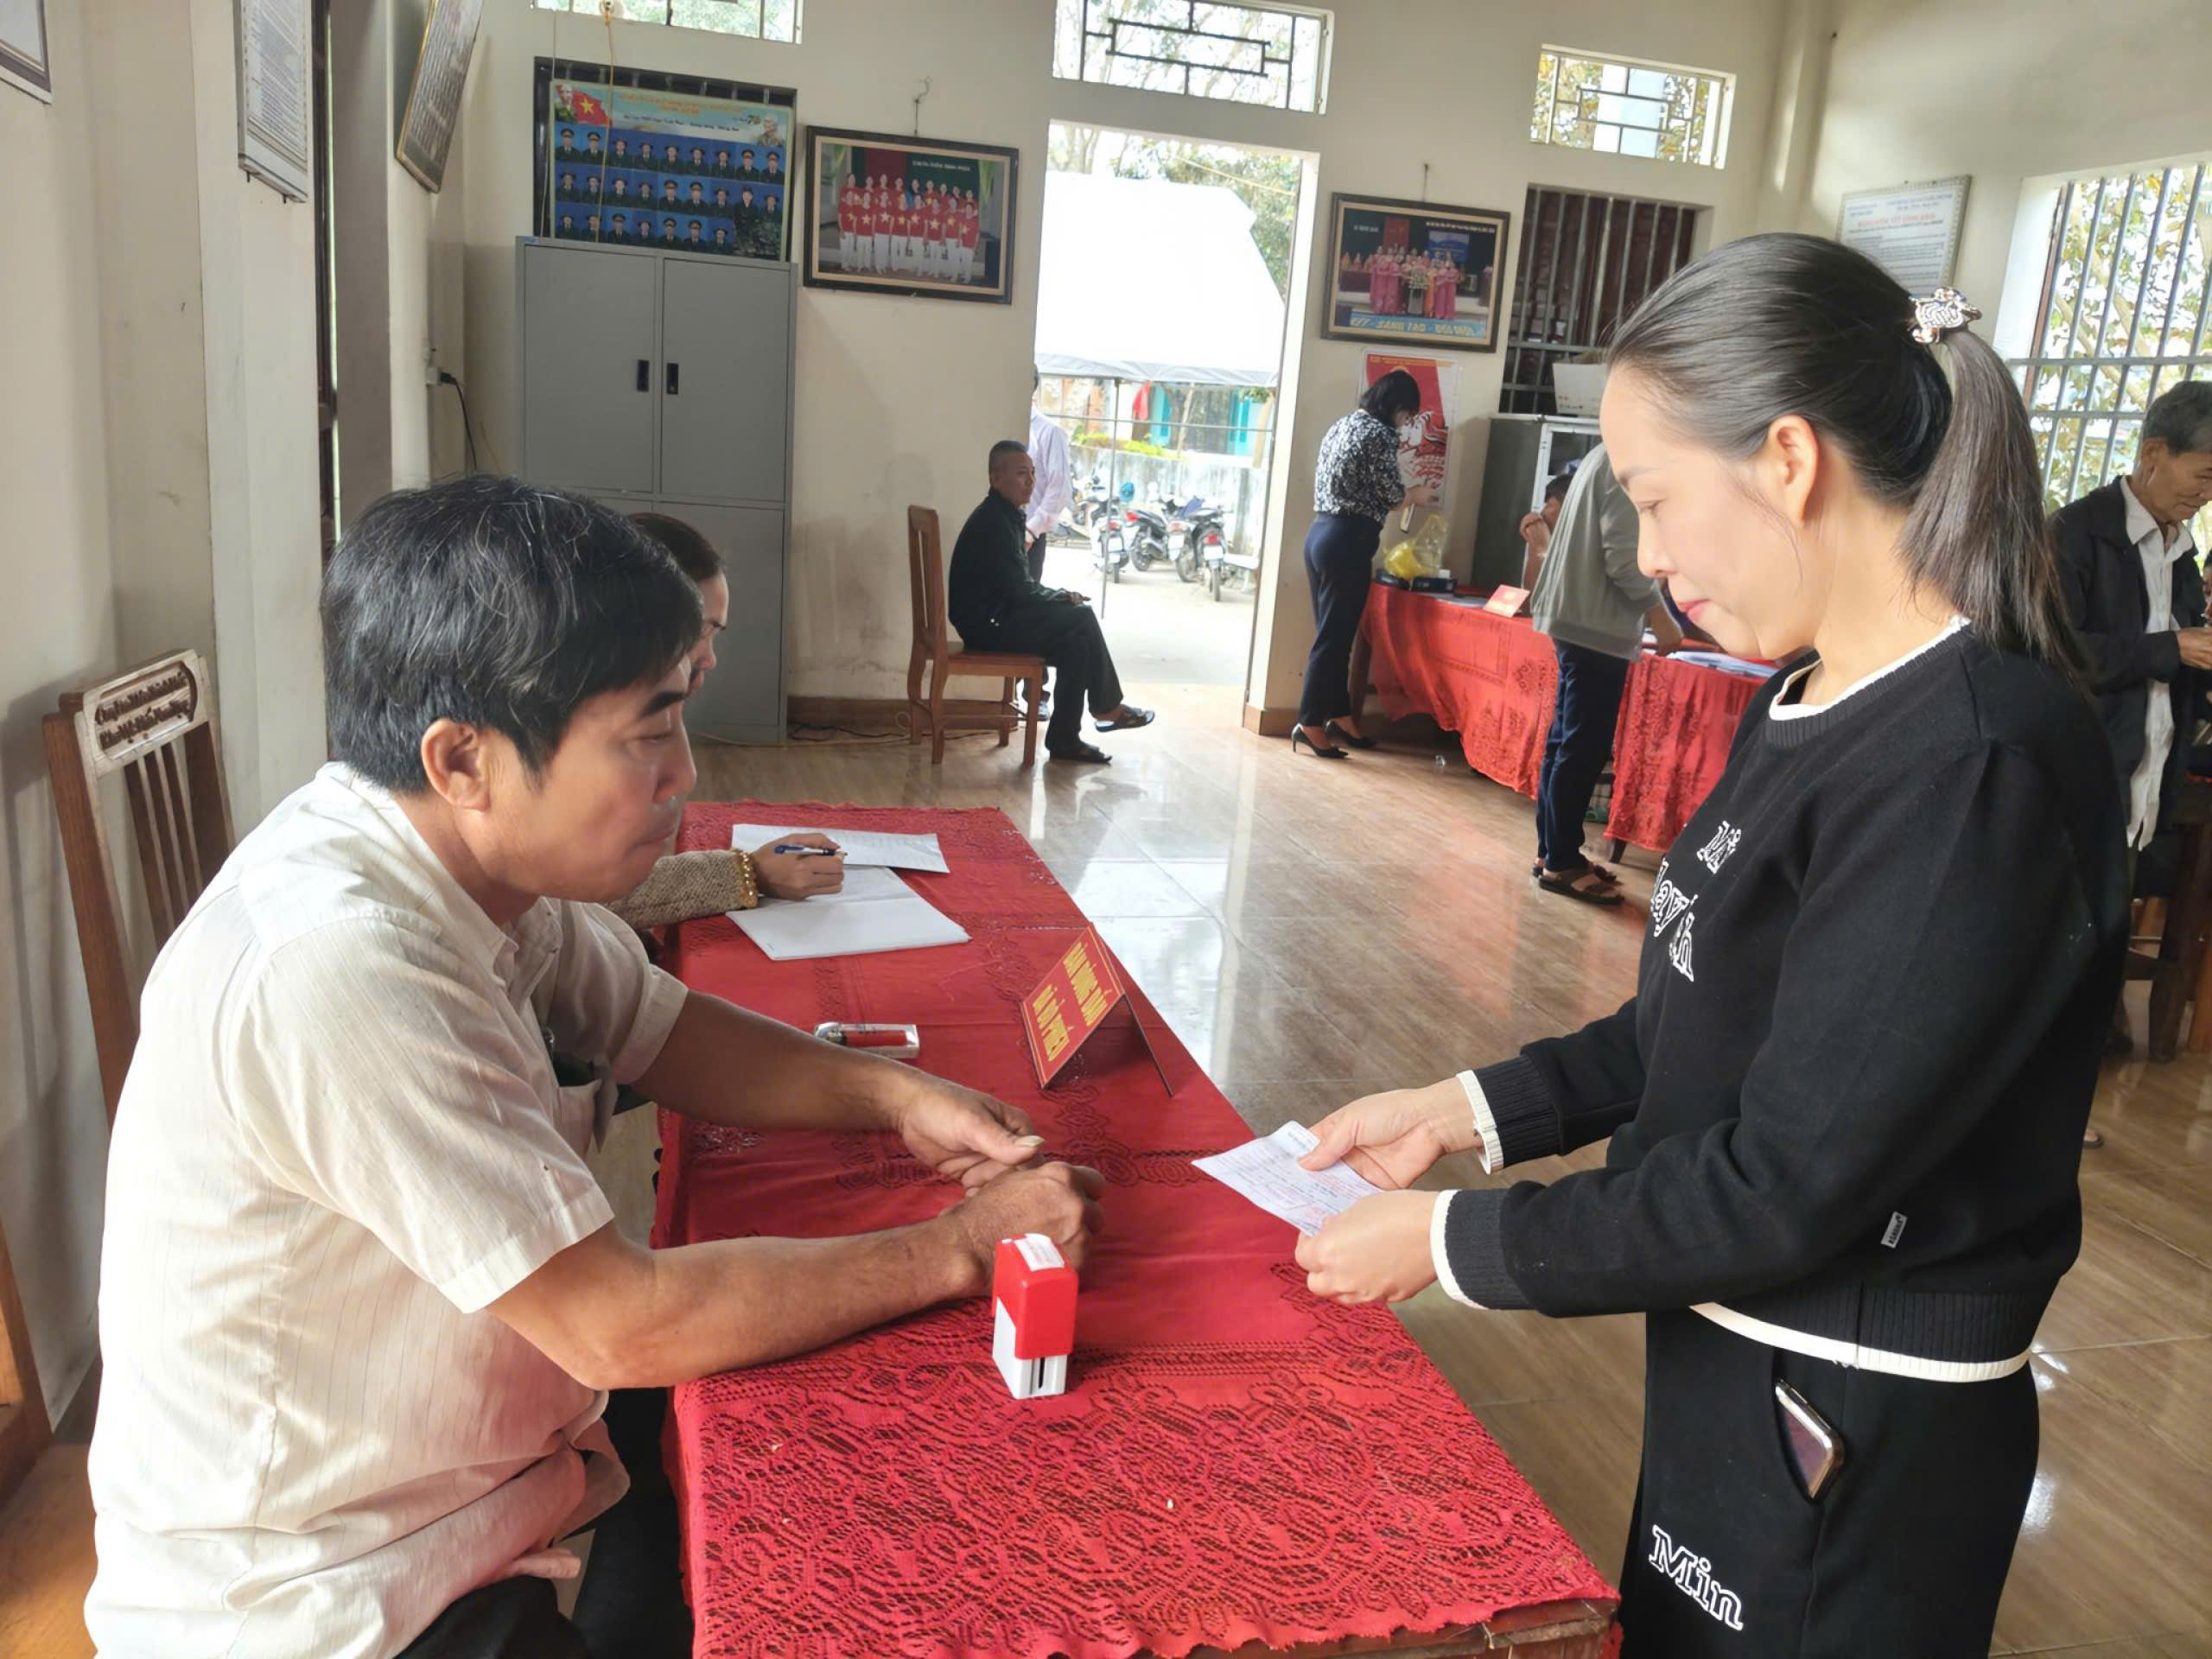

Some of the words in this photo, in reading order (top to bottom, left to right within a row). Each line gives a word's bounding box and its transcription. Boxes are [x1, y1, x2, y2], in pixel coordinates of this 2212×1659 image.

[1080, 987, 1113, 1027] DẤU
[1040, 1012, 1075, 1063] PHIẾU
[1649, 1524, 1744, 1630] Min
